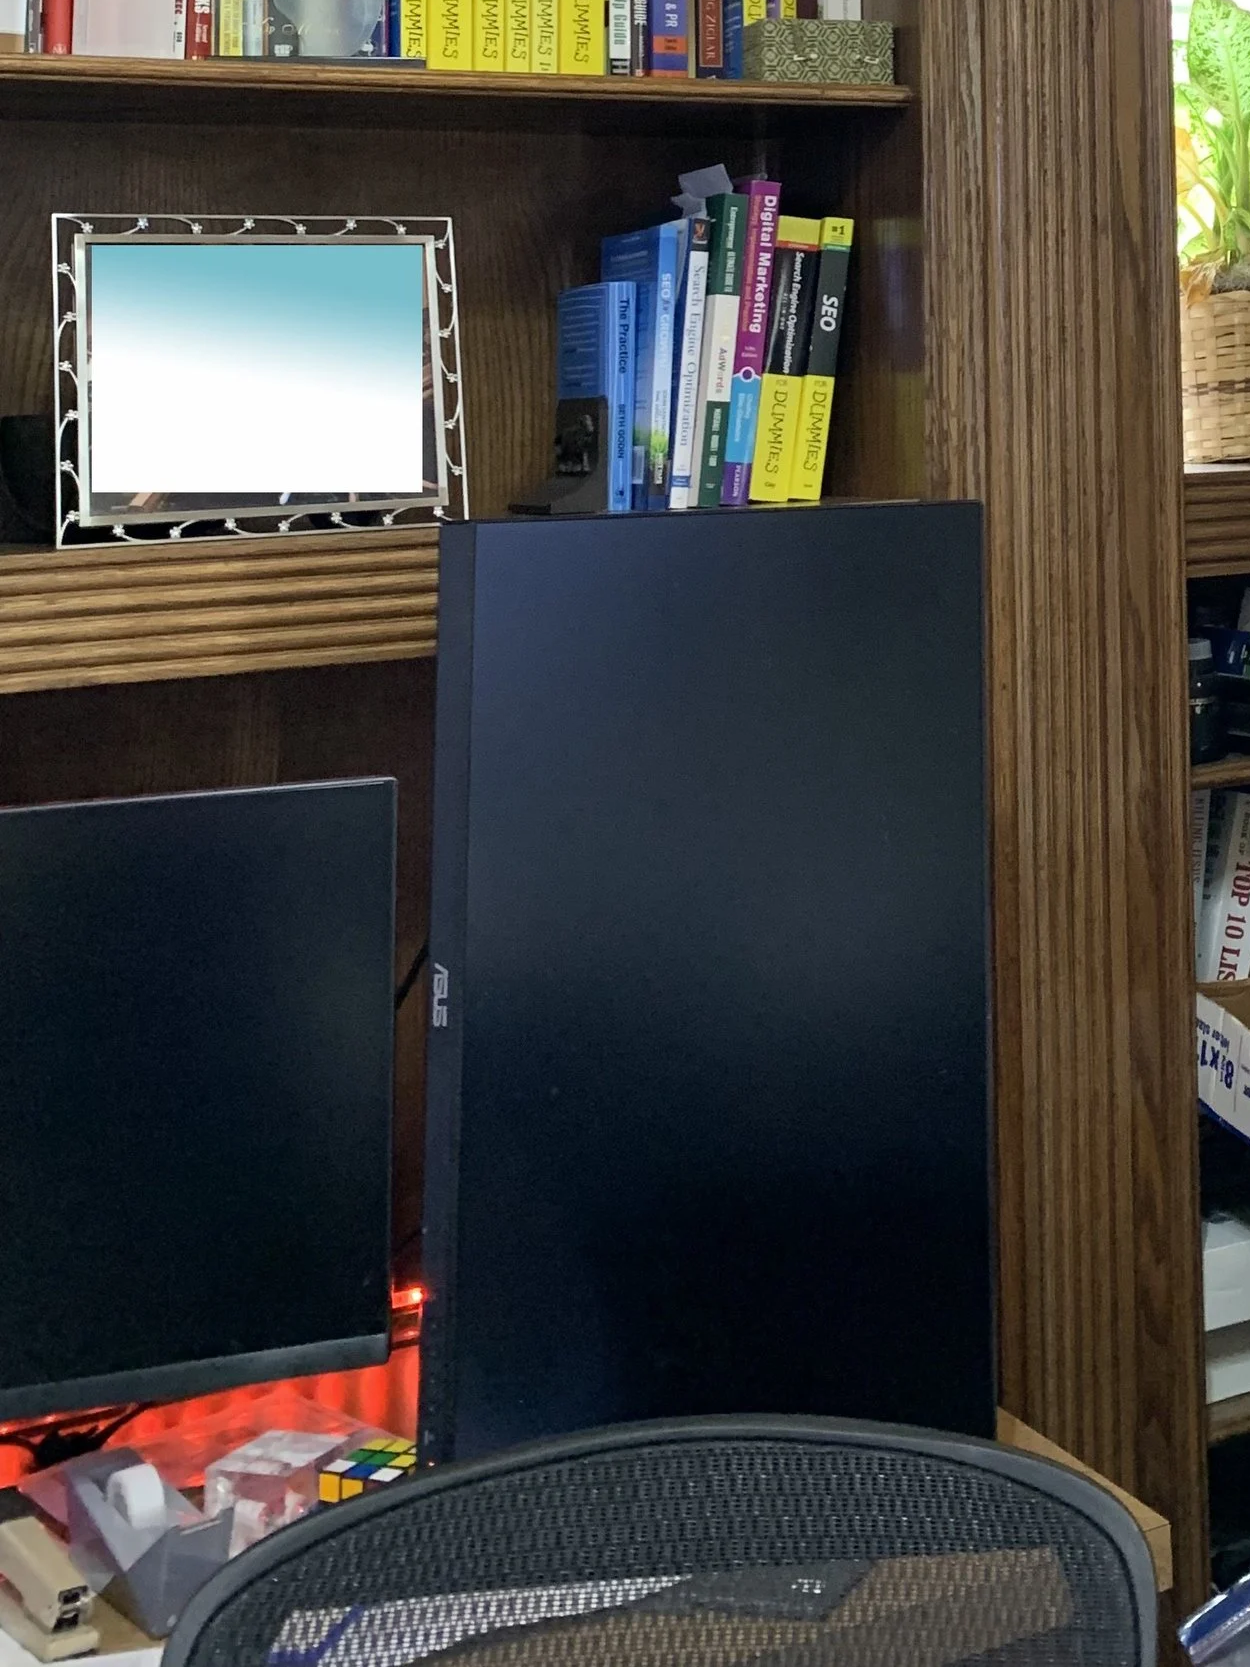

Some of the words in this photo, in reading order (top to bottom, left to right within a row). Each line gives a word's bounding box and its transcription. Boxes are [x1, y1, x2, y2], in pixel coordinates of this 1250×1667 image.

[666, 3, 678, 11] &
[666, 14, 678, 27] PR
[705, 14, 718, 60] ZIGLAR
[759, 195, 778, 247] Digital
[618, 298, 630, 330] The
[749, 252, 773, 333] Marketing
[819, 294, 840, 332] SEO
[616, 332, 630, 375] Practice
[766, 390, 787, 475] DUMMIES
[804, 390, 828, 473] DUMMIES
[1225, 913, 1247, 940] 10
[1217, 946, 1241, 980] LIS
[433, 963, 448, 1027] ASUS
